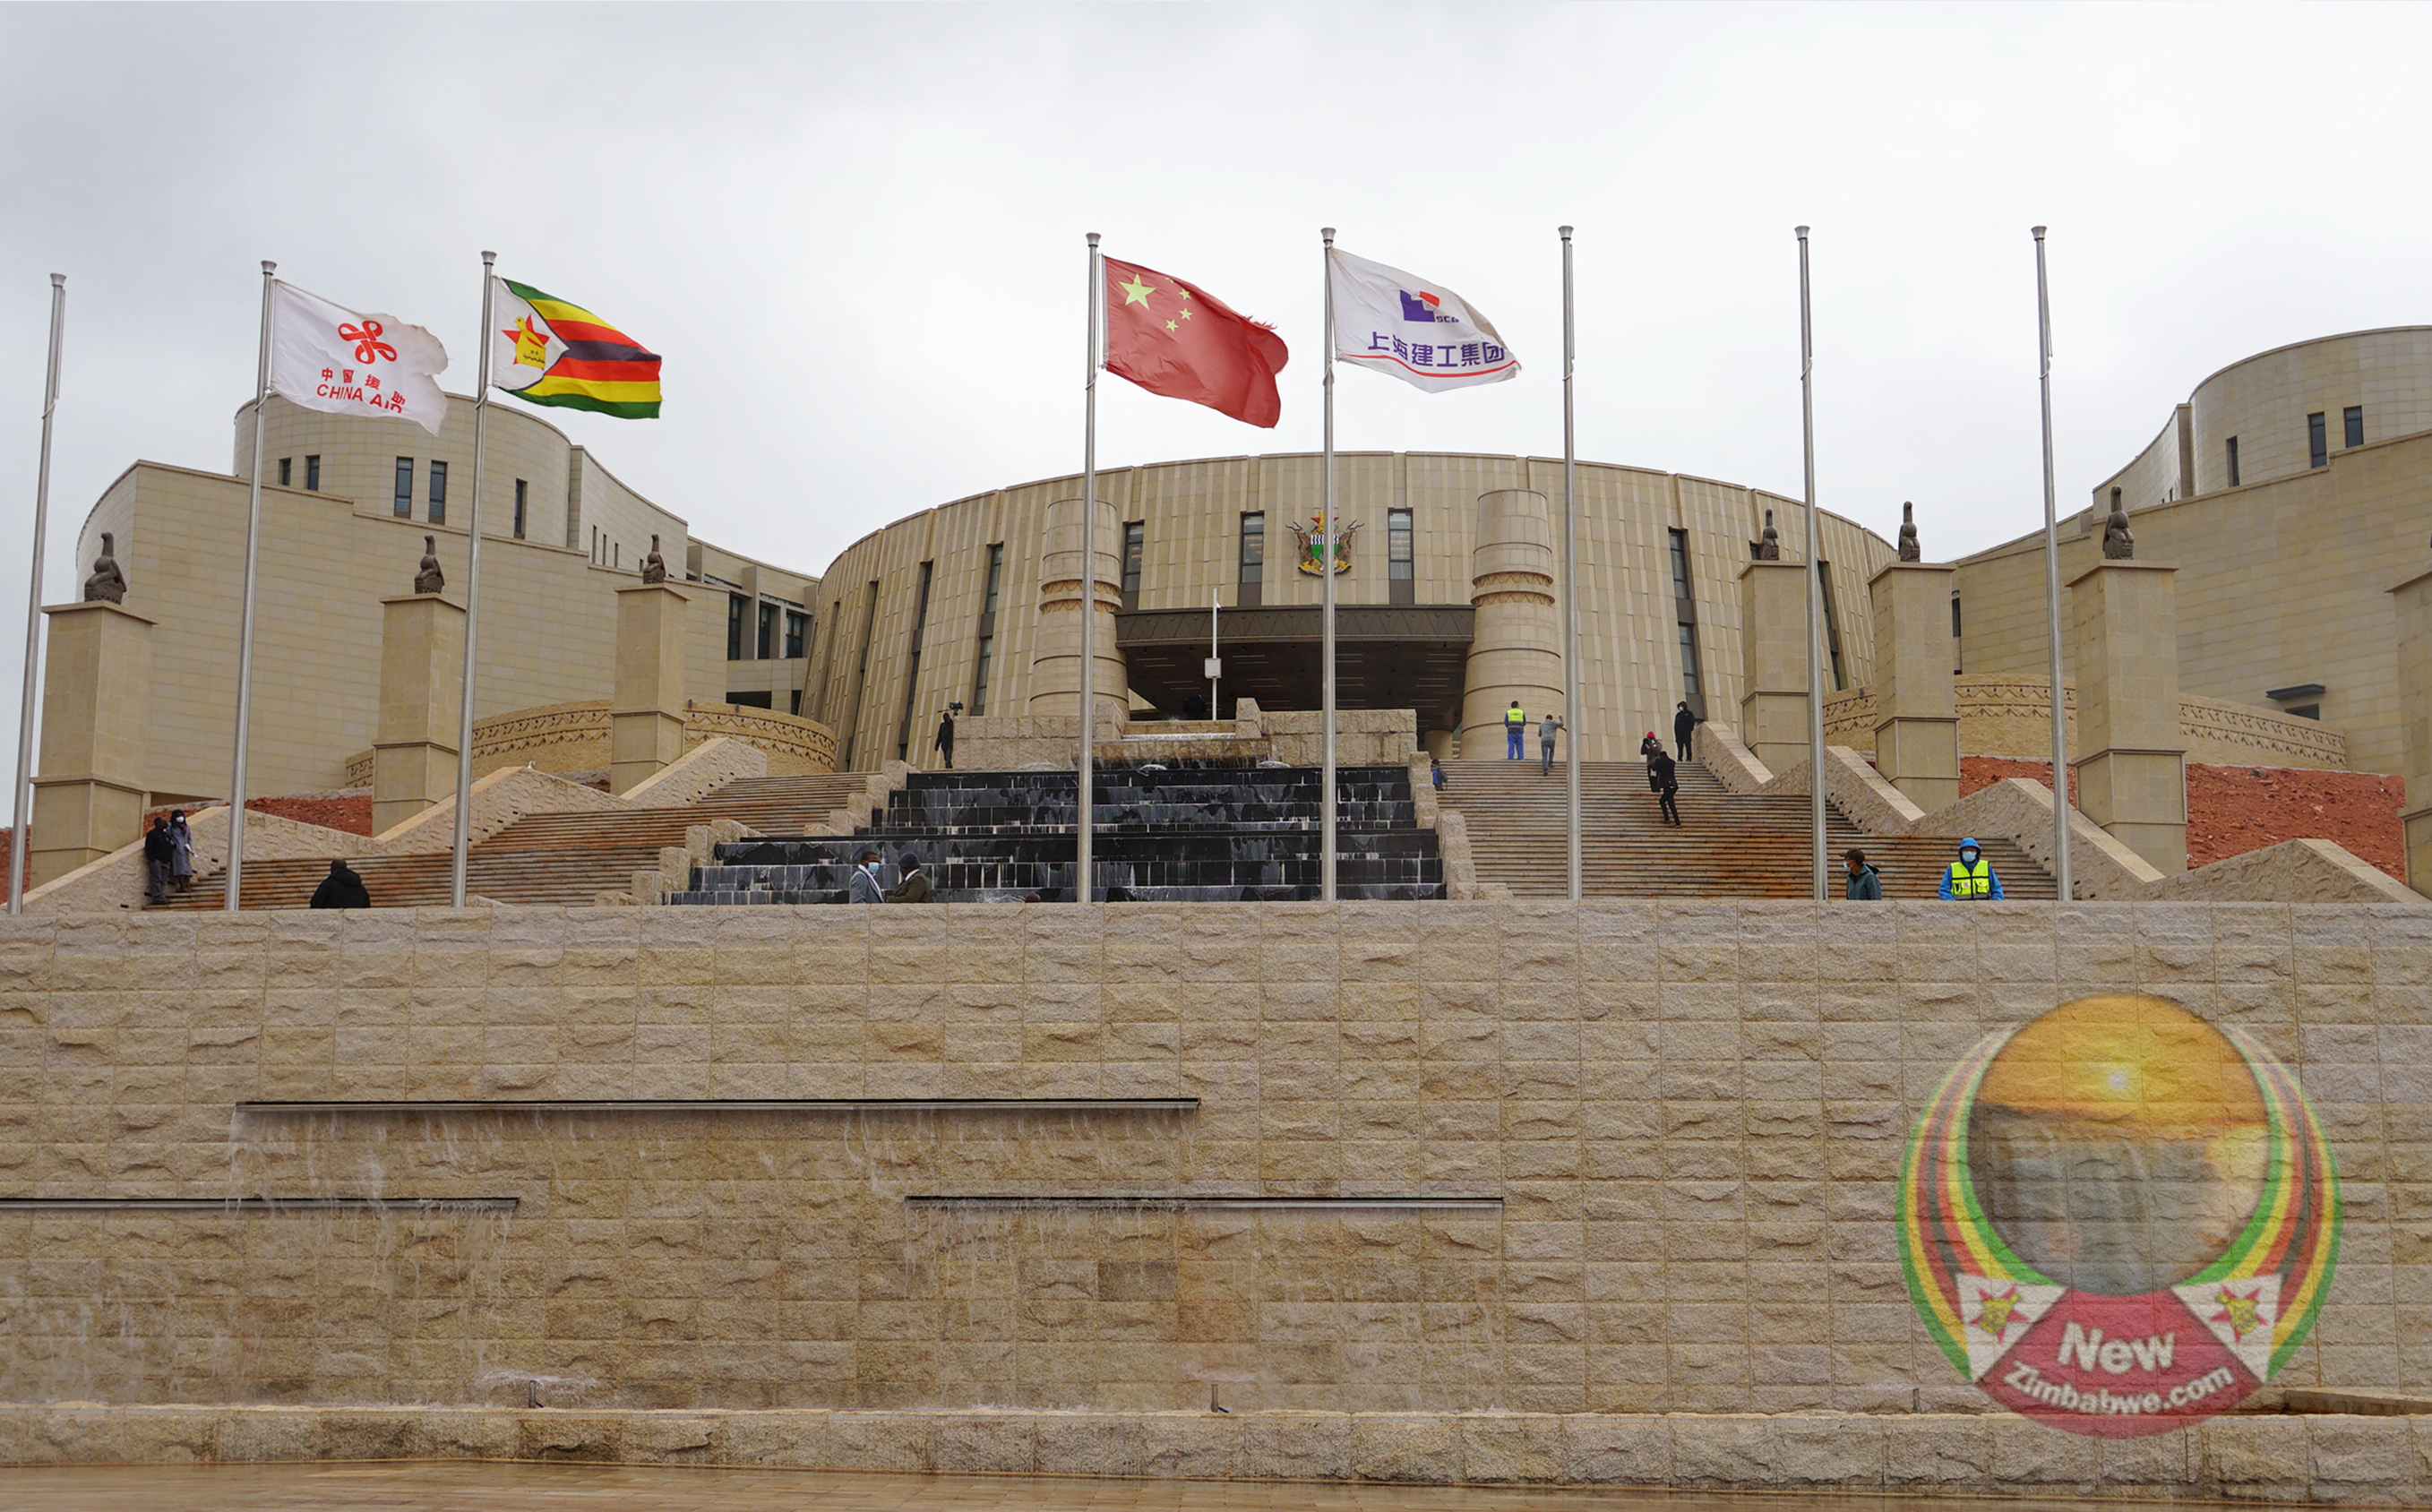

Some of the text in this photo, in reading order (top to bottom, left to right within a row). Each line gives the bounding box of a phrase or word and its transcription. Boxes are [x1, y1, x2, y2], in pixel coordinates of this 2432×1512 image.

[1368, 331, 1505, 367] 上海建工集团
[316, 383, 364, 402] CHINA
[322, 367, 406, 405] 中国援助
